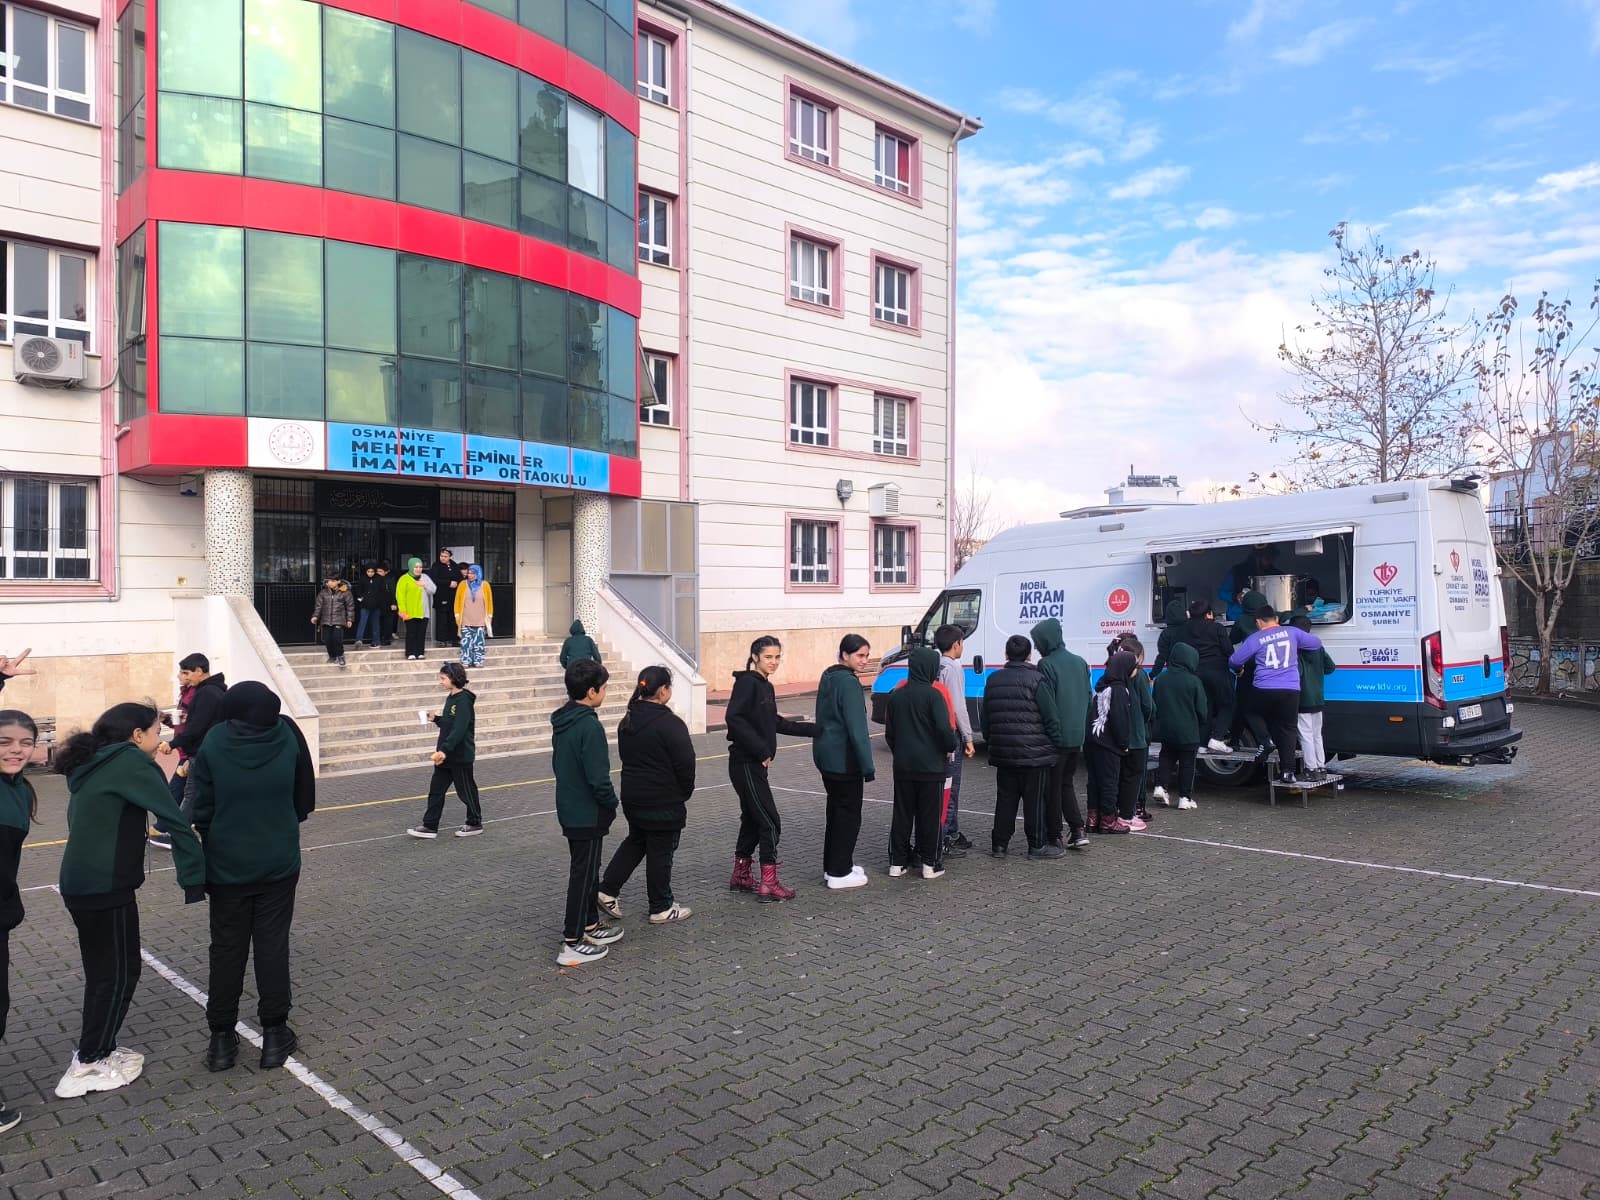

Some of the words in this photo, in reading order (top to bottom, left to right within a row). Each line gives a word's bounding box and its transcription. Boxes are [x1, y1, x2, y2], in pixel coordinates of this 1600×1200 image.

[351, 428, 435, 443] OSMANİYE
[351, 440, 445, 459] MEHMET
[466, 450, 543, 469] EMİNLER
[351, 453, 415, 472] İMAM
[424, 461, 484, 476] HATİP
[498, 467, 587, 487] ORTAOKULU
[1019, 604, 1063, 618] ARACI
[1360, 609, 1411, 618] OSMANİYE
[1265, 640, 1290, 669] 47
